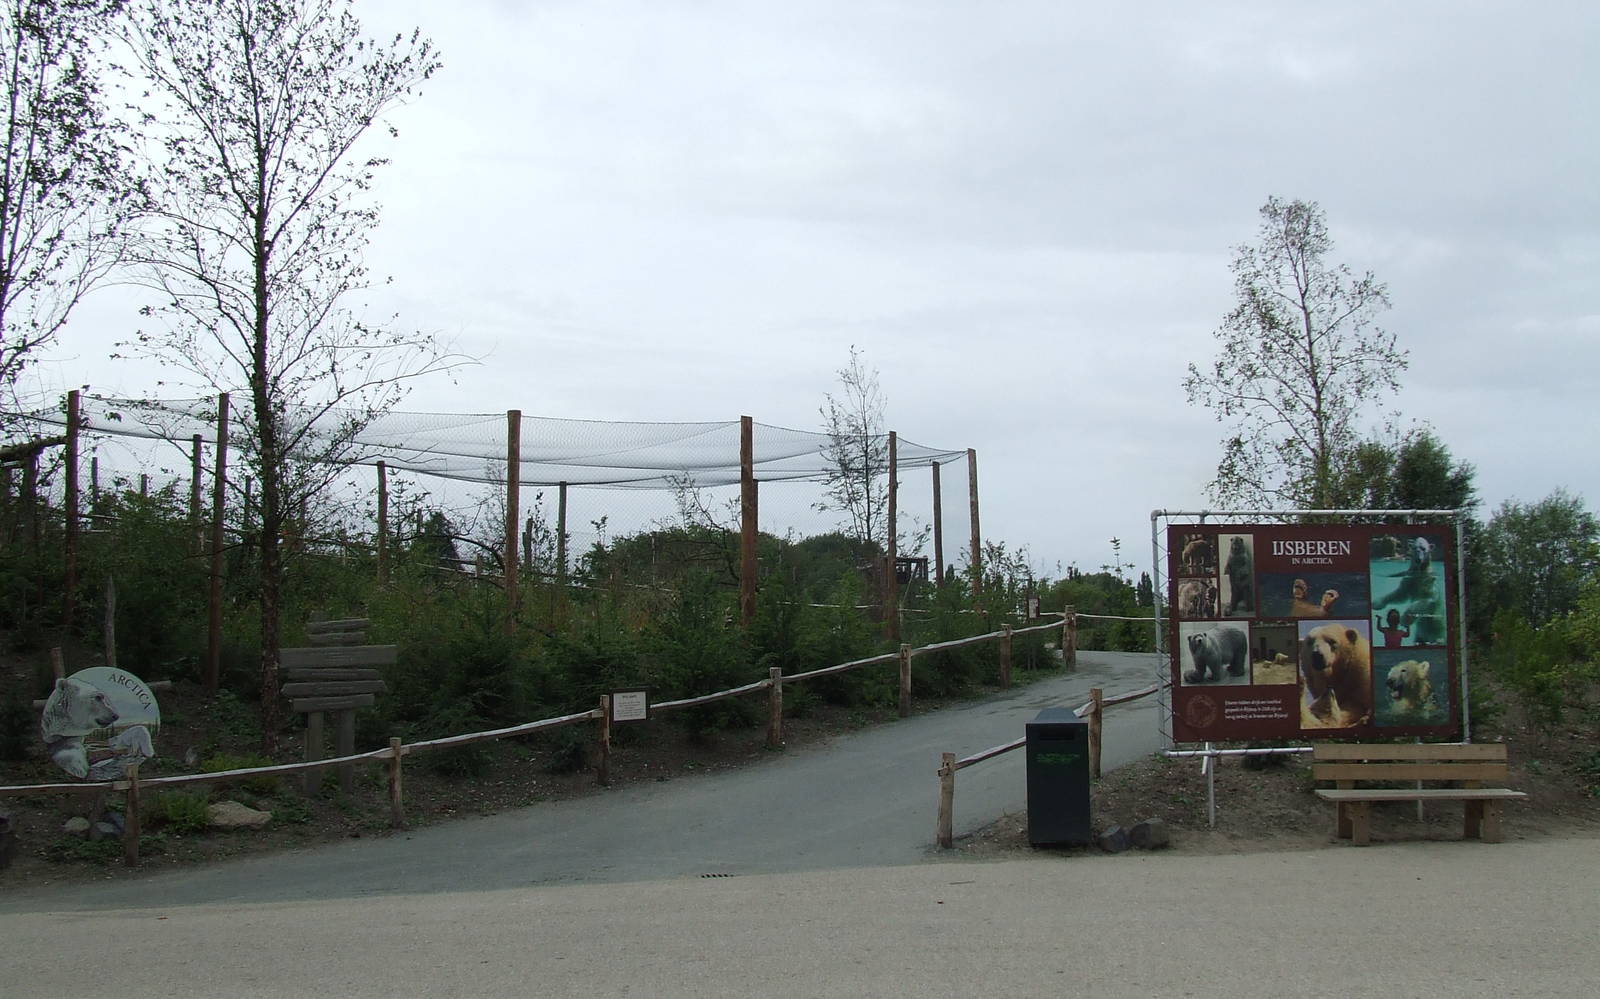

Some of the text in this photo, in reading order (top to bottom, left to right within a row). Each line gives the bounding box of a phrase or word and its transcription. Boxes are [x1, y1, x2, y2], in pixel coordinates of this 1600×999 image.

[1272, 540, 1352, 556] IJSBEREN
[1292, 557, 1333, 565] IN ARCTICA
[108, 673, 152, 710] ARCTICA
